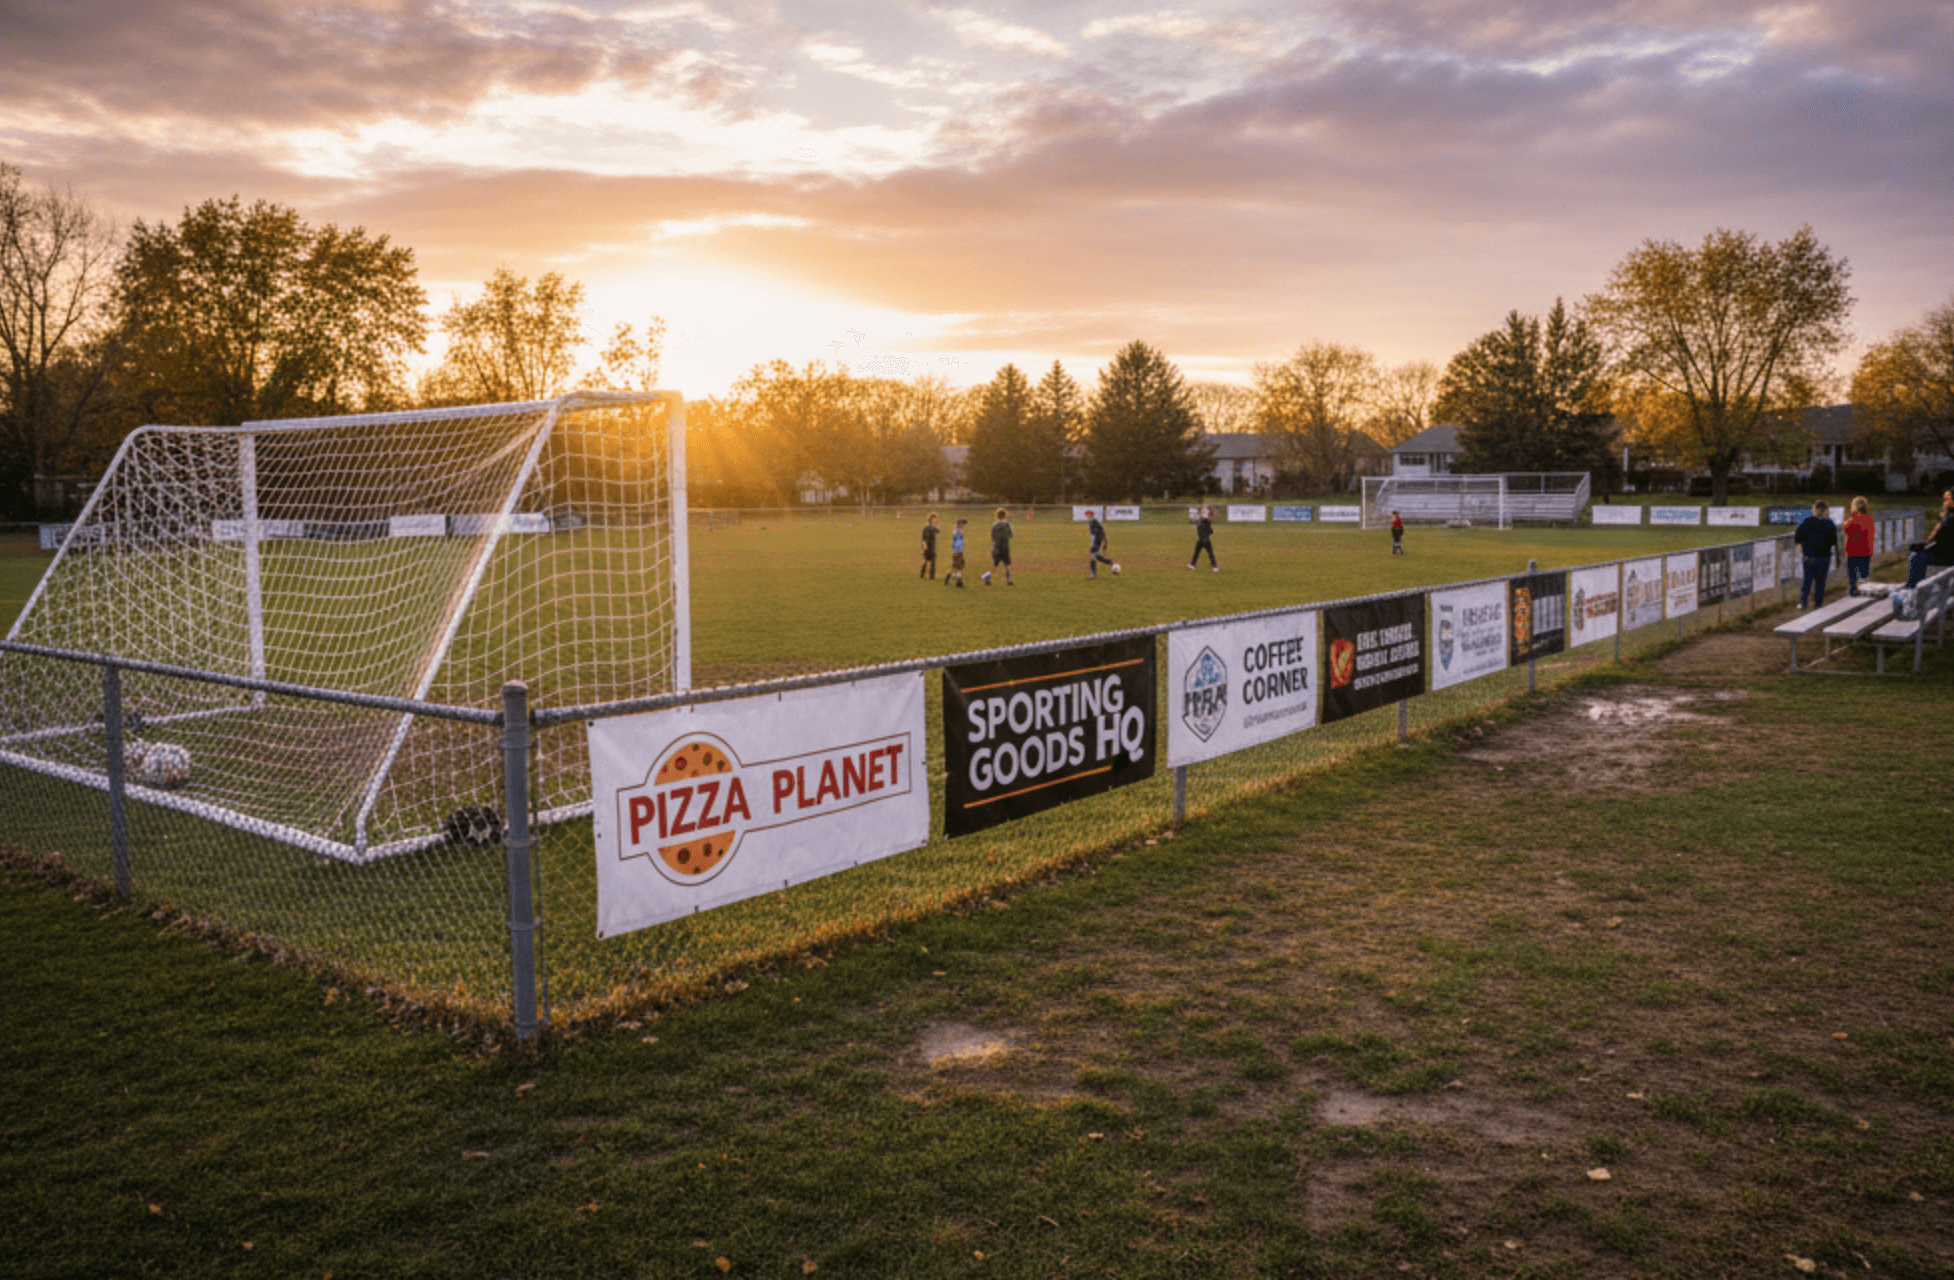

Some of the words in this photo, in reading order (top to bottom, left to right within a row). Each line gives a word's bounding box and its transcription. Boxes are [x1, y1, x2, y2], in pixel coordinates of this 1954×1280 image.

[967, 674, 1124, 743] SPORTING
[1242, 667, 1308, 705] CORNER
[969, 726, 1086, 791] GOODS
[1096, 705, 1145, 763] HQ
[629, 776, 751, 845] PIZZA
[772, 743, 904, 815] PLANET
